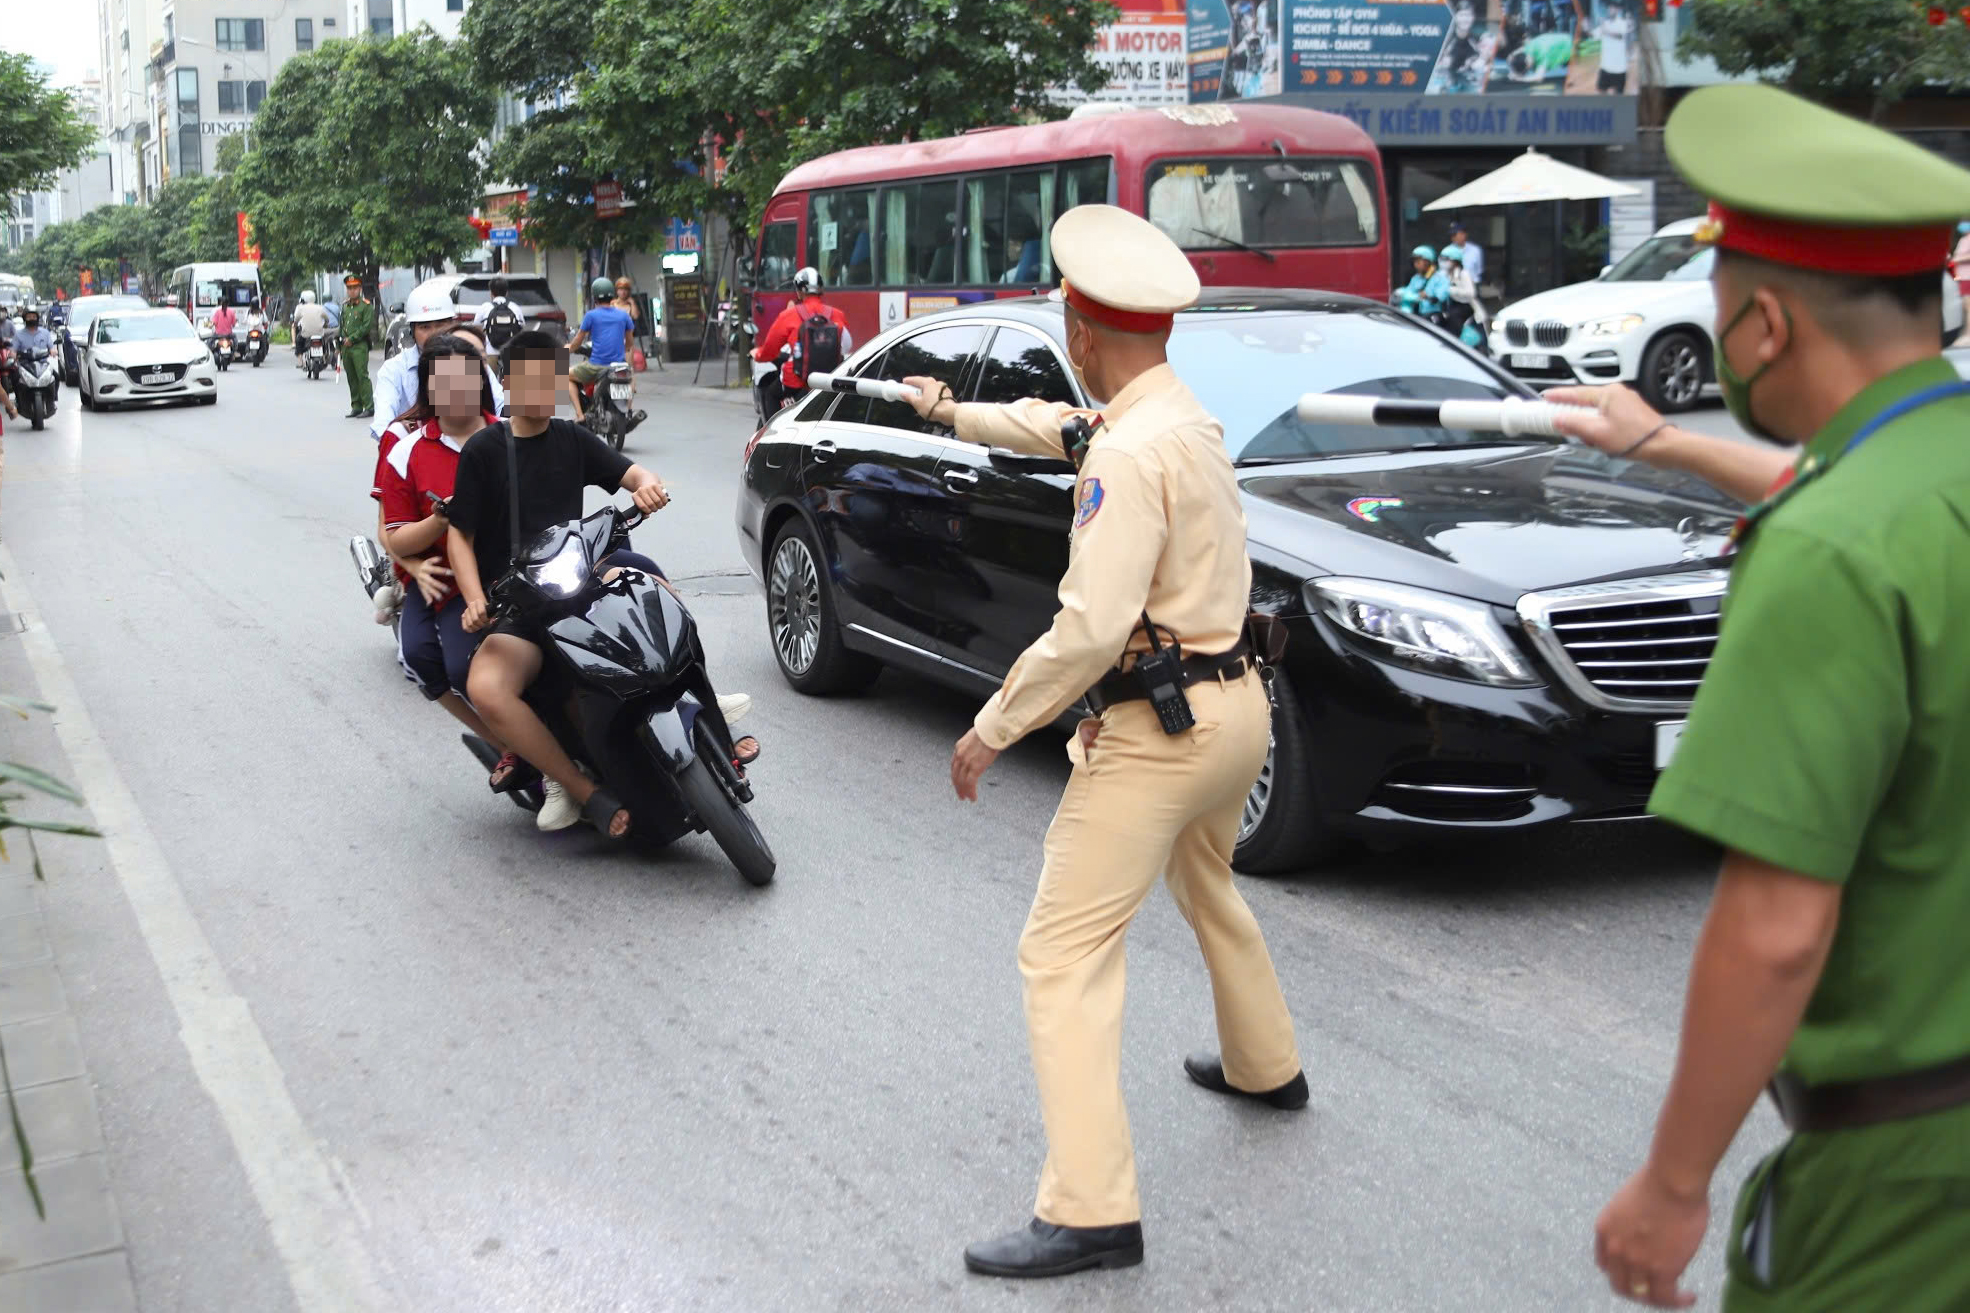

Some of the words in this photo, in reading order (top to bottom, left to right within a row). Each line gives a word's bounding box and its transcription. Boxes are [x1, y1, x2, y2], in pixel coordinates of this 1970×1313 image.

[1353, 8, 1379, 20] GYM
[1410, 24, 1441, 37] YOGA
[1115, 32, 1183, 52] MOTOR
[1293, 39, 1328, 50] ZUMBA
[1334, 40, 1372, 51] DANCE
[1148, 61, 1160, 80] XE
[1379, 99, 1441, 135] KIỂM
[1449, 102, 1509, 135] SOÁT
[1515, 107, 1548, 135] AN
[1556, 108, 1614, 134] NINH
